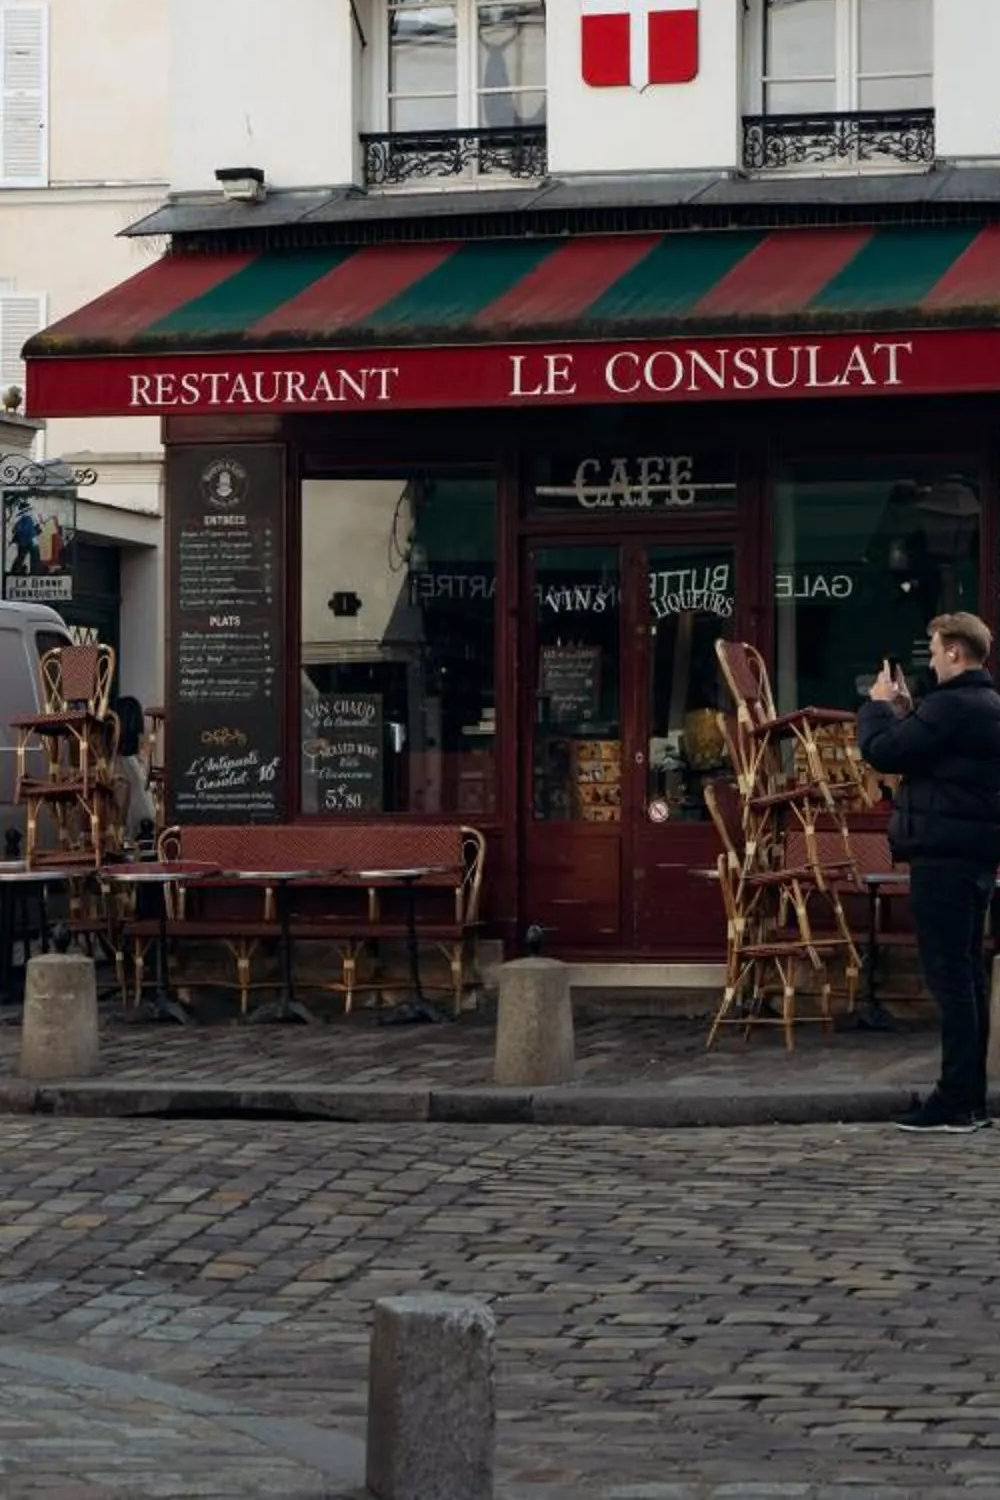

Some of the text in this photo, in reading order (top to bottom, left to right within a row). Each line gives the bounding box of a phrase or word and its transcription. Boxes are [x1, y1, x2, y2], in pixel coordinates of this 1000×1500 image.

[129, 341, 912, 407] RESTAURANT LE CONSULAT
[545, 587, 607, 613] VINS
[650, 591, 735, 619] LIQUEURS
[209, 615, 241, 627] PLATS
